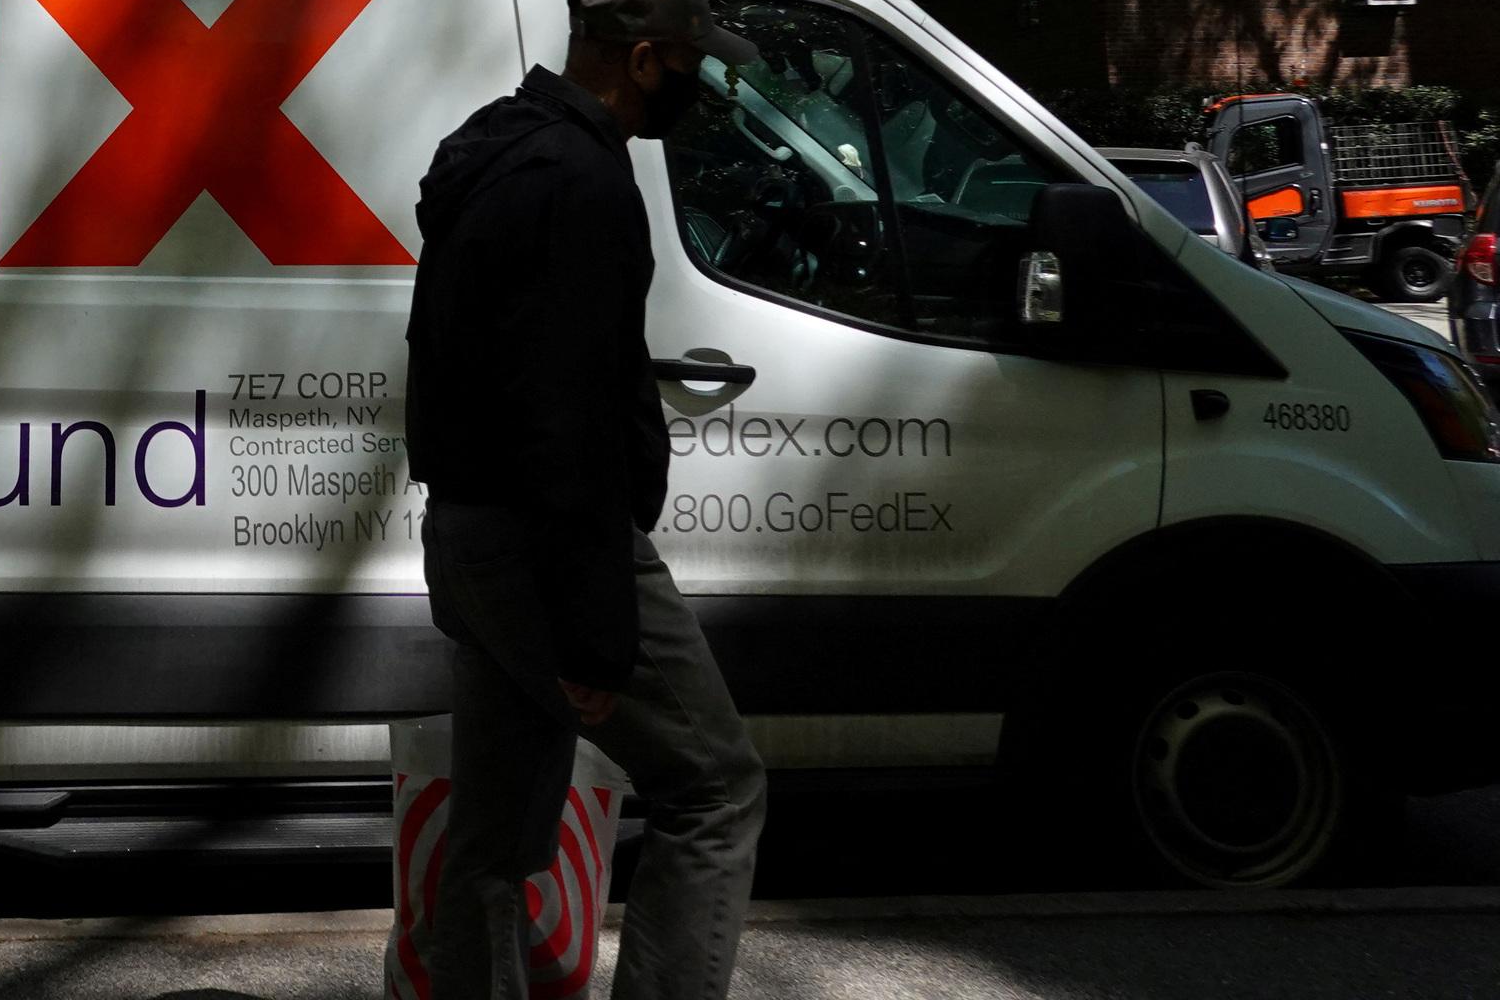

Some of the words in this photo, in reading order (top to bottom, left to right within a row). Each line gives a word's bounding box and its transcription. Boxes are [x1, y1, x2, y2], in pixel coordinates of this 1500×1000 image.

[228, 373, 285, 400] 7E7
[297, 372, 388, 399] CORP.
[229, 407, 337, 432] Maspeth,
[347, 405, 382, 425] NY
[1263, 402, 1350, 432] 468380
[229, 433, 354, 456] Contracted
[231, 465, 278, 496] 300
[288, 463, 396, 504] Maspeth
[233, 513, 344, 551] Brooklyn
[354, 510, 392, 542] NY
